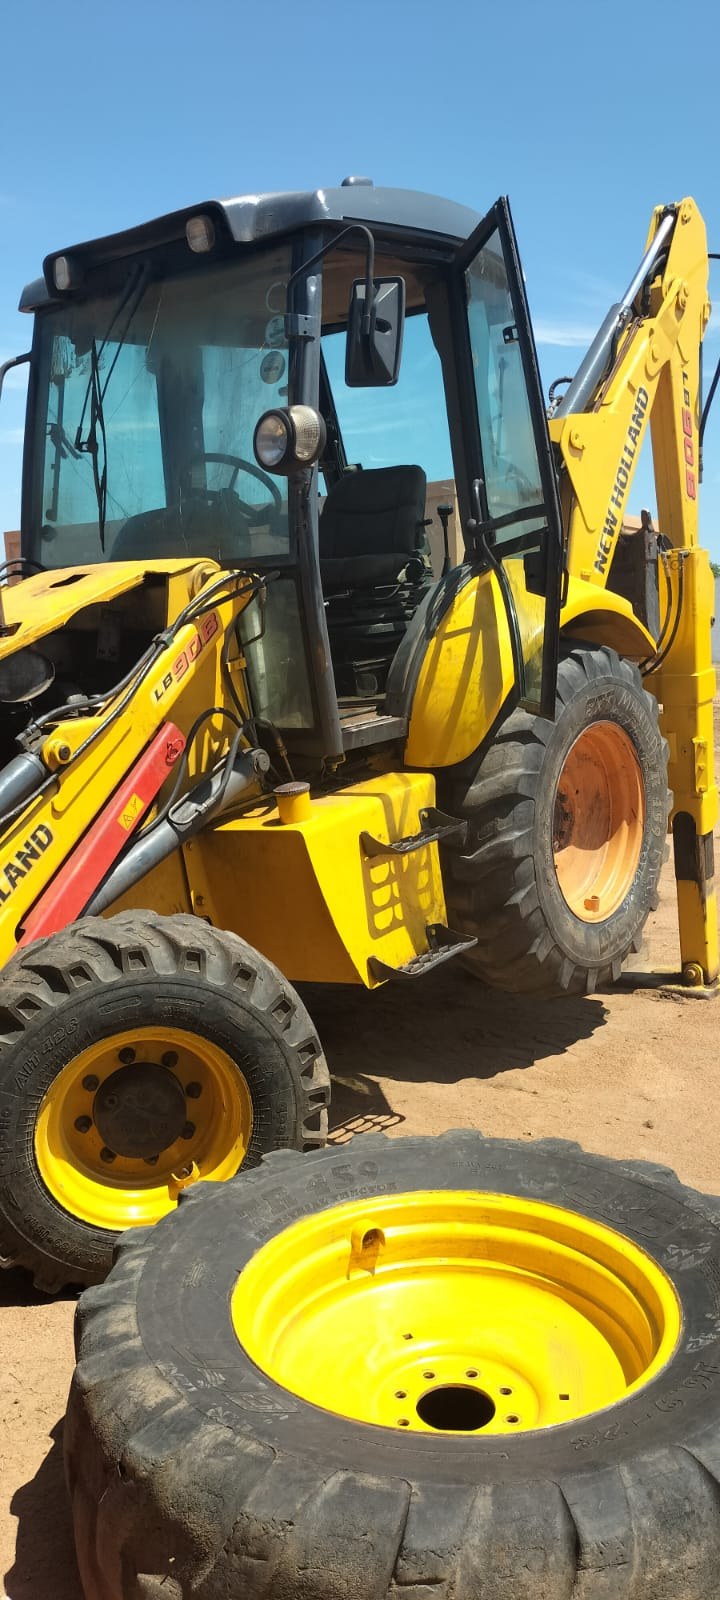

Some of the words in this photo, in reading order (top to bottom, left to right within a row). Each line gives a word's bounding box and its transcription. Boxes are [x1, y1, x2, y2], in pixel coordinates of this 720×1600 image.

[593, 509, 619, 574] NEW
[610, 386, 649, 509] HOLLAND
[0, 823, 53, 907] LAND
[304, 1160, 379, 1196] 459
